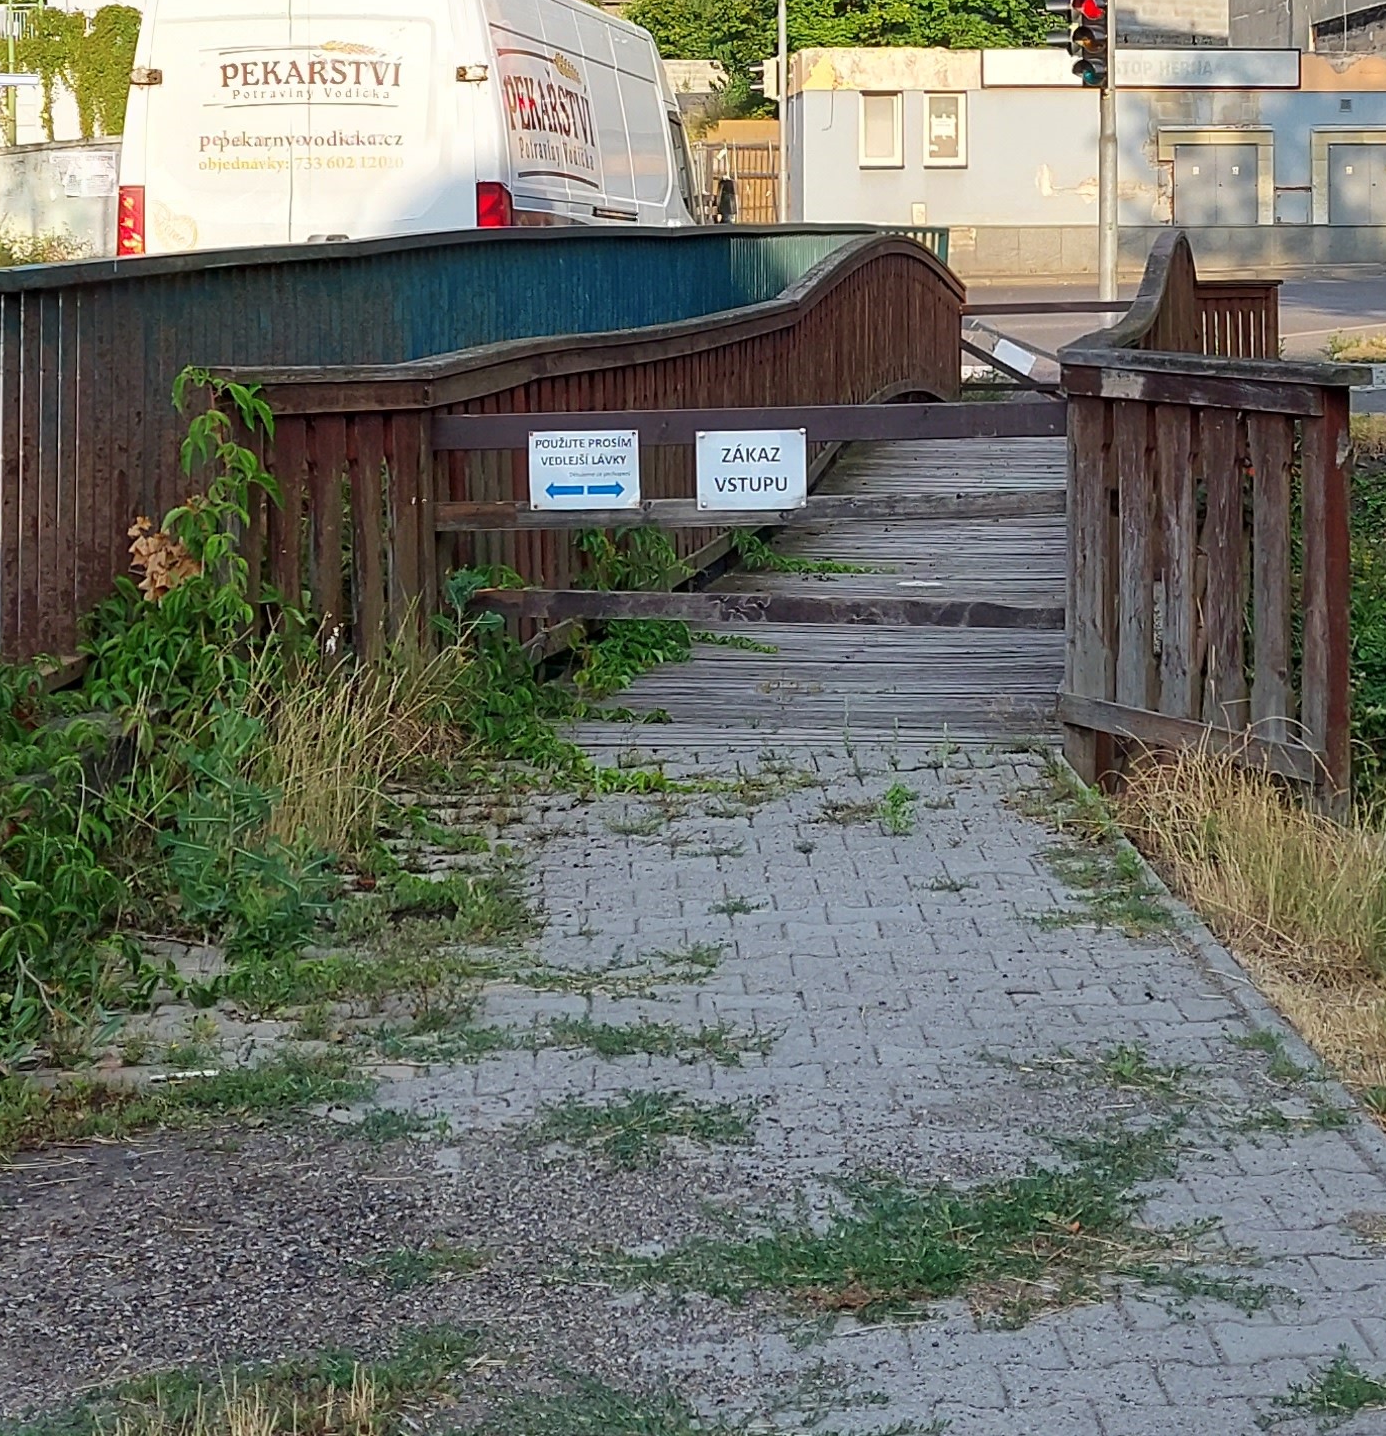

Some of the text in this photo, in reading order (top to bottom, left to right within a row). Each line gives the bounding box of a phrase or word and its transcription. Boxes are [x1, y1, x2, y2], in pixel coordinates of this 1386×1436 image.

[219, 53, 403, 87] PEKAŘSTVÍ
[232, 88, 313, 100] Potraviny
[502, 67, 595, 148] PEKAŘSTVÍ
[519, 136, 560, 167] Potraviny
[535, 436, 632, 449] POUŽIJTE PROSÍM
[541, 453, 627, 466] VEDLEJŠÍ LÁVKY
[721, 443, 781, 463] ZÁKAZ
[714, 476, 788, 493] VSTUPU
